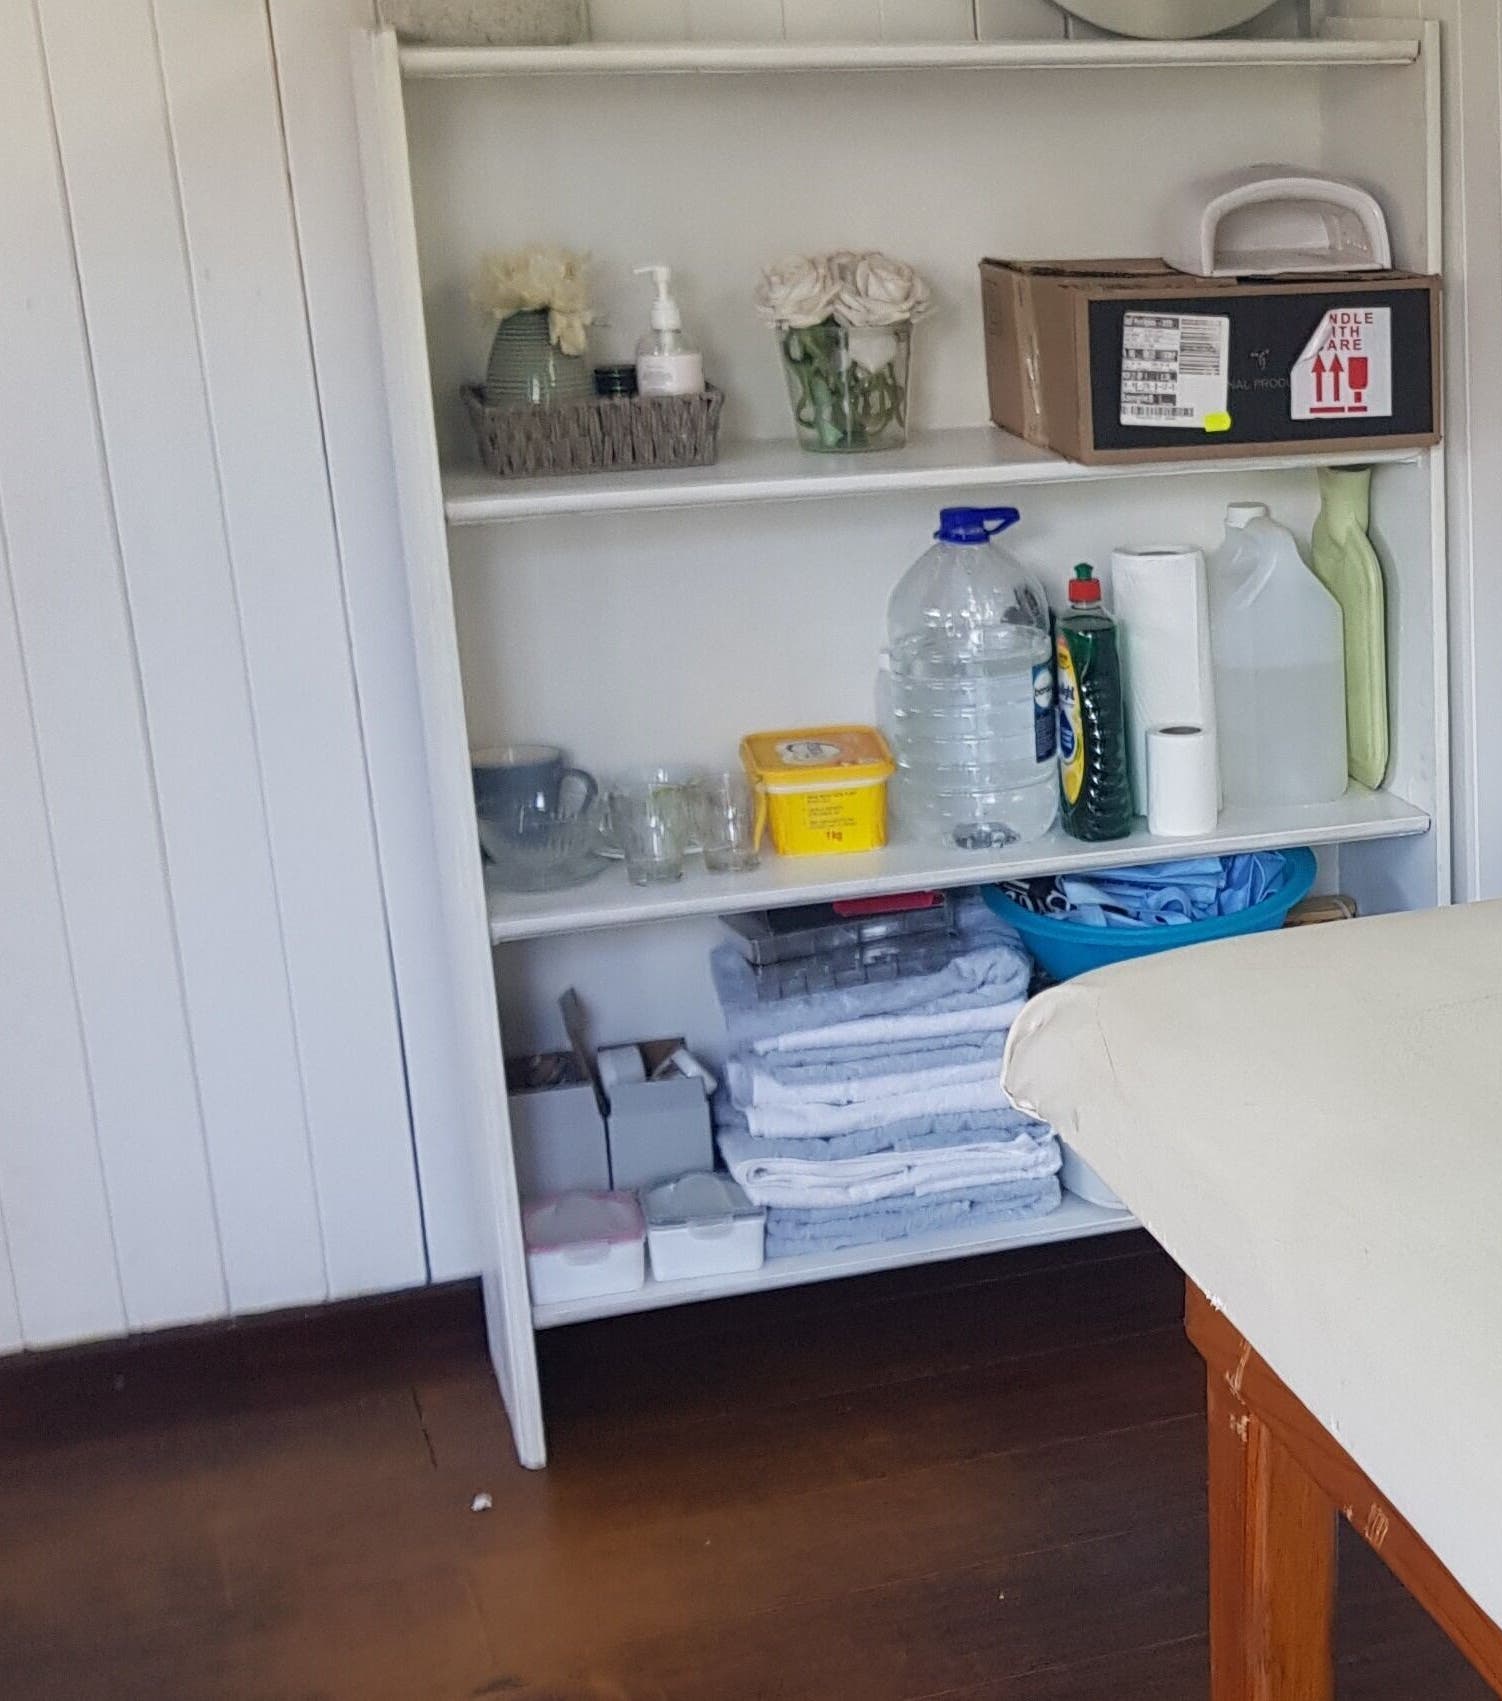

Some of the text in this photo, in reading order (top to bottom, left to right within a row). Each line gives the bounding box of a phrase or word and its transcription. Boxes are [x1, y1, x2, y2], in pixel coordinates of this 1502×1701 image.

[1329, 312, 1373, 324] NDLE
[1332, 326, 1359, 337] ITH
[1328, 339, 1362, 350] ARE
